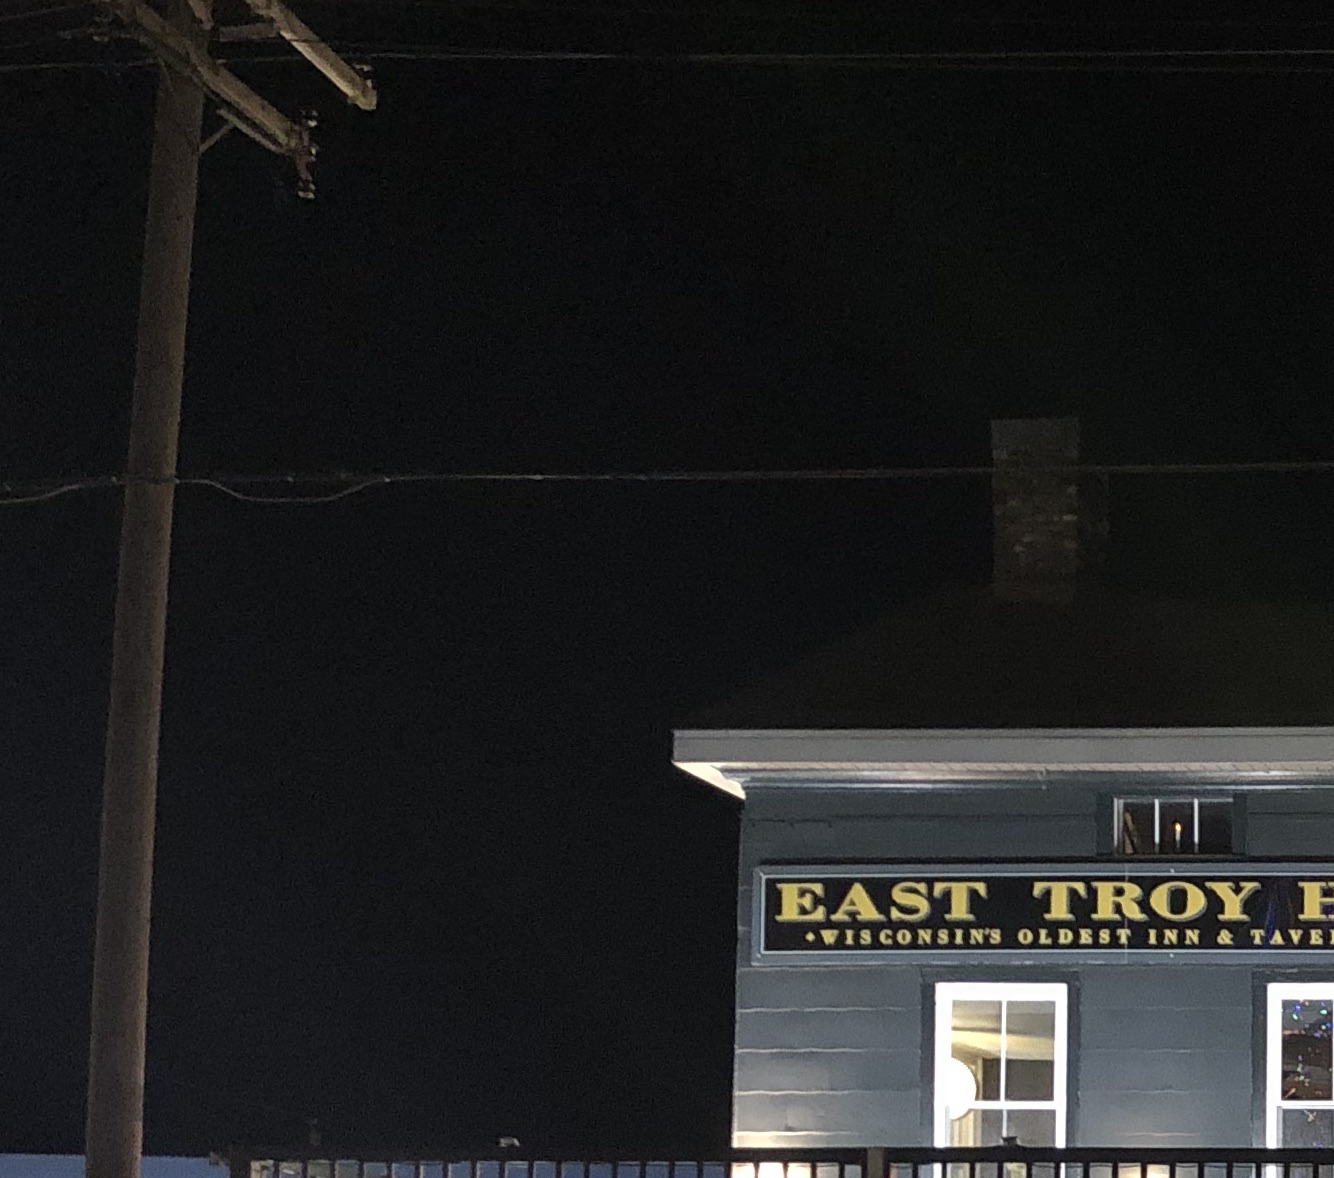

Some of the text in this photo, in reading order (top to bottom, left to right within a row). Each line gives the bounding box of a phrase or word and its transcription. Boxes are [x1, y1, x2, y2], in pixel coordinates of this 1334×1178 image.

[775, 881, 988, 922] EAST
[1033, 880, 1261, 922] TROY
[819, 928, 1002, 945] WISCONSIN'S
[1017, 928, 1132, 945] OLDEST
[1148, 928, 1201, 945] INN
[1216, 928, 1234, 945] &
